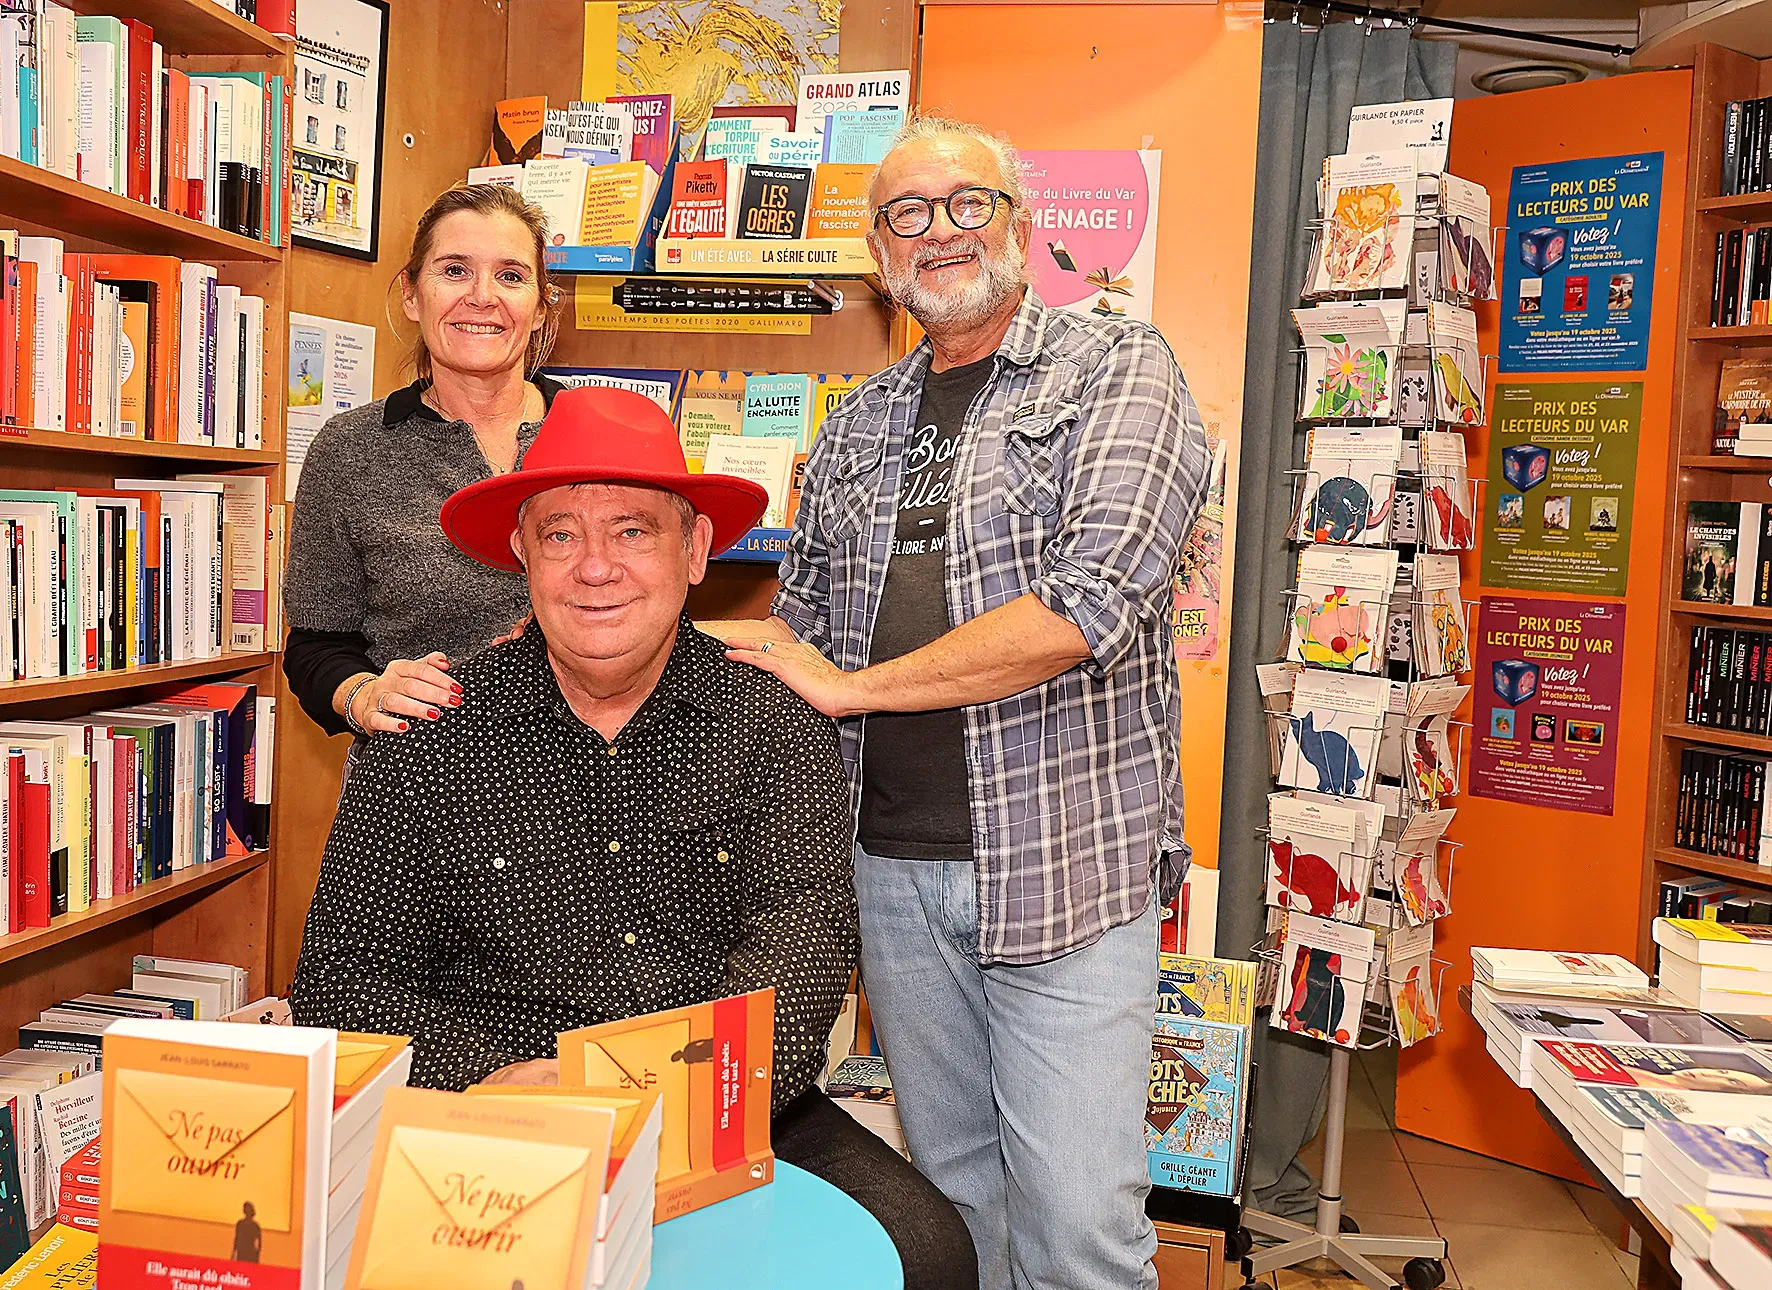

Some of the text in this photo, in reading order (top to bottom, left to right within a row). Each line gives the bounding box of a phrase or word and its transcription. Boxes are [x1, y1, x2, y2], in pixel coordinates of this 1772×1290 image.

[807, 81, 900, 99] GRAND ATLAS
[502, 109, 540, 118] Matin brun
[812, 101, 857, 114] 2026
[1351, 112, 1388, 121] GUIRLANDE
[1400, 108, 1424, 117] PAPIER
[606, 117, 619, 131] QUI
[839, 114, 899, 122] POP FASCISME
[707, 120, 752, 132] COMMENT
[566, 129, 623, 148] NOUS DÉFINIT ?
[770, 138, 820, 148] Savoir
[780, 151, 821, 162] périr
[750, 170, 806, 181] VICTOR CASTANET
[686, 181, 718, 196] Piketty
[824, 185, 838, 195] La
[1043, 188, 1136, 200] du Livre du Var
[1550, 177, 1616, 197] PRIX DES
[761, 183, 789, 209] LES
[822, 195, 868, 206] nouvelle
[1517, 193, 1650, 217] LECTEURS DU VAR
[746, 207, 797, 234] OGRES
[1032, 203, 1133, 230] MÉNAGE !
[818, 219, 860, 230] fasciste
[1573, 219, 1621, 245] Votez !
[690, 250, 705, 263] UN
[707, 248, 727, 263] ÉTÉ
[762, 250, 776, 263] LA
[777, 248, 804, 263] SÉRIE
[807, 250, 838, 263] CULTE
[1580, 252, 1604, 260] octobre
[1605, 251, 1622, 259] 2025
[596, 315, 648, 324] PRINTEMPS
[652, 316, 670, 324] DES
[675, 317, 710, 325] POÈTES
[716, 318, 740, 326] 2020
[749, 319, 803, 328] GALLIMARD
[749, 382, 802, 391] CYRIL DION
[747, 396, 800, 408] LA LUTTE
[1533, 401, 1597, 416] PRIX DES
[747, 408, 799, 418] ENCHANTÉE
[688, 422, 731, 431] vous voterez
[1501, 419, 1629, 433] LECTEURS DU VAR
[686, 440, 705, 448] peine
[1555, 442, 1602, 467] Votez !
[721, 466, 767, 475] invincibles
[1552, 473, 1560, 481] 19
[748, 538, 761, 550] LA
[51, 570, 57, 581] DE
[1180, 609, 1206, 624] EST
[1519, 616, 1582, 634] PRIX DES
[1487, 631, 1613, 654] LECTEURS DU VAR
[1720, 642, 1730, 678] MINIER
[1736, 643, 1746, 679] MINIER
[1751, 645, 1760, 682] MINIER
[1544, 663, 1590, 686] Votez !
[1550, 692, 1573, 701] octobre
[1574, 693, 1591, 702] 2025
[720, 1040, 730, 1129] Elle aurait dû obéir.
[730, 1059, 740, 1106] Trop tard.
[55, 1094, 95, 1115] Horvilleur
[58, 1112, 89, 1130] Benzine
[168, 1108, 244, 1151] Ne pas
[167, 1153, 246, 1181] ouvrir
[1160, 1161, 1217, 1177] GRILLE GÉANTE
[1169, 1171, 1207, 1187] À DÉPLIER
[440, 1172, 526, 1219] Ne pas
[432, 1223, 522, 1254] ouvrir
[36, 1235, 66, 1265] Lenoir
[147, 1260, 251, 1287] Elle aurait dû obéir.
